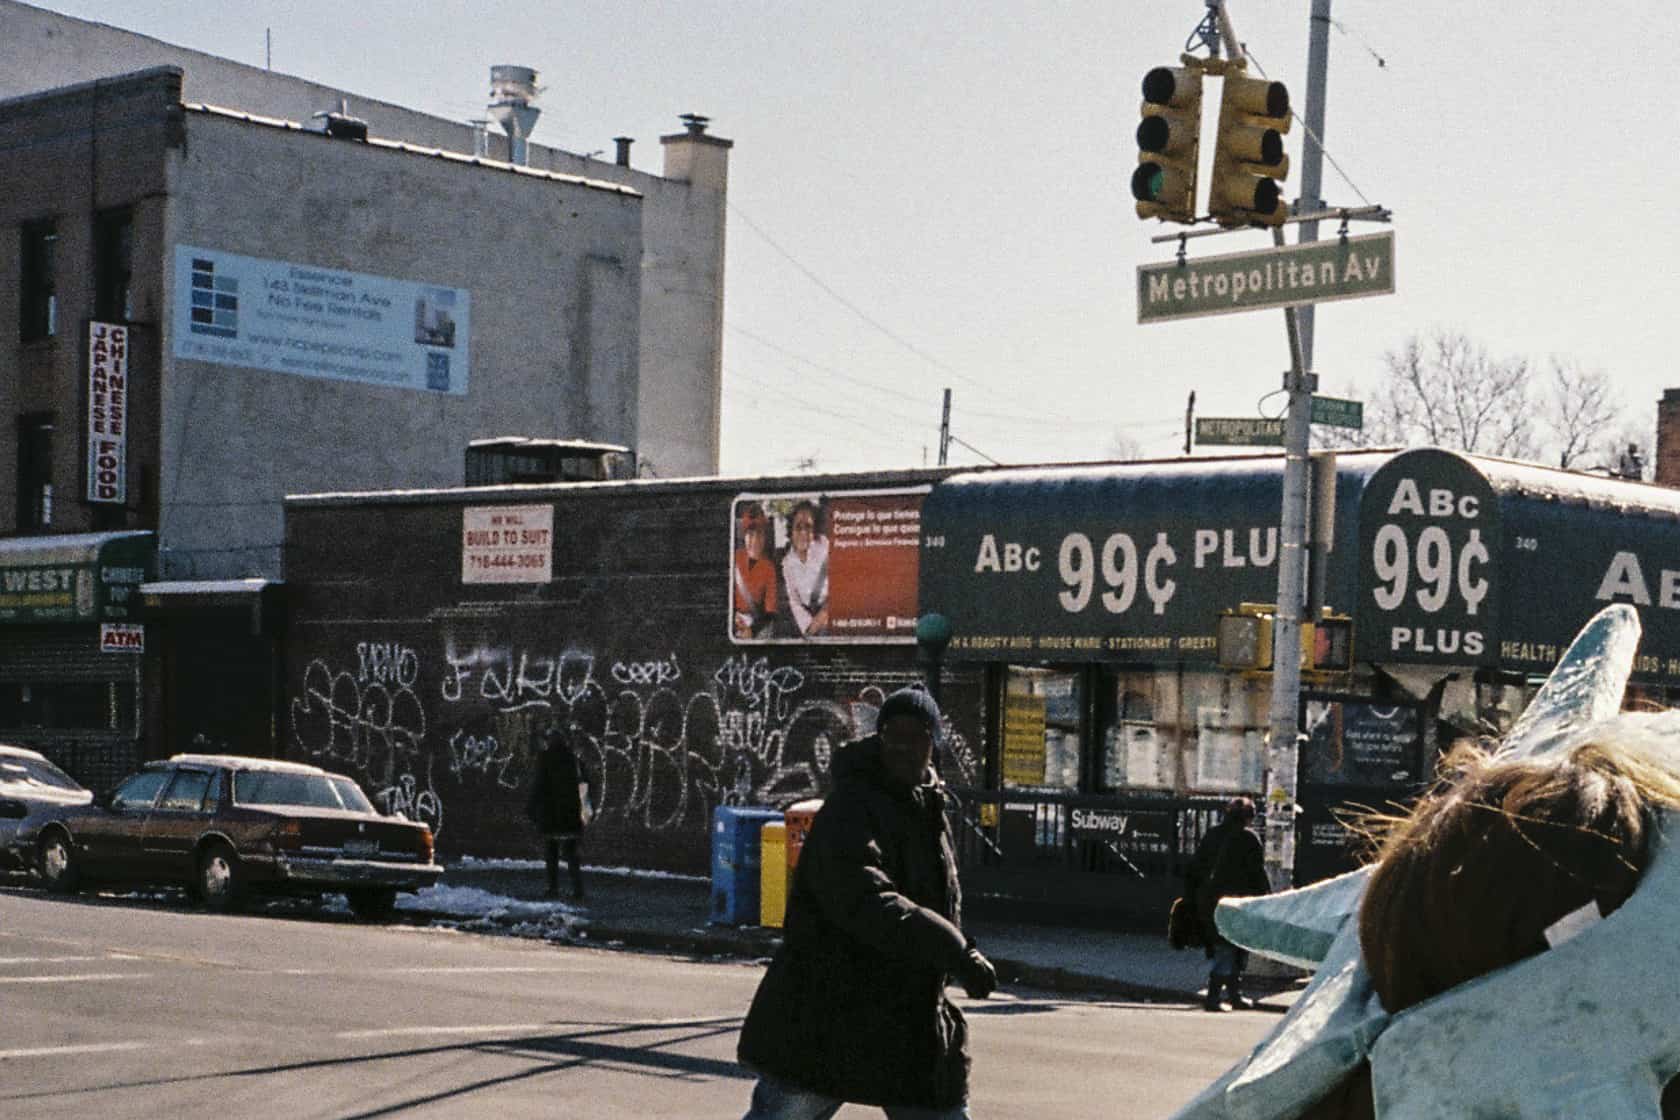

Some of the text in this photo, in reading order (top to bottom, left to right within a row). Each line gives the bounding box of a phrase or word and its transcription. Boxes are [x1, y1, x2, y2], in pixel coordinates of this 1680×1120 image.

[1147, 252, 1380, 303] Metropolitan Av
[93, 326, 107, 434] JAPANESE
[109, 327, 124, 436] CHINESE
[98, 441, 118, 500] FOOD
[467, 529, 548, 546] BUILD TO SUIT
[1193, 526, 1278, 569] PLU
[1514, 536, 1538, 550] 340
[3, 569, 74, 592] WEST
[1057, 531, 1177, 614] 99¢
[1371, 525, 1491, 615] 99¢
[103, 631, 142, 647] ATM
[1039, 636, 1073, 649] HOUSE
[1109, 635, 1171, 649] STATIONARY
[1177, 635, 1217, 649] GREETI
[1390, 626, 1485, 657] PLUS
[1500, 639, 1557, 662] HEALTH
[1071, 809, 1129, 835] Subway
